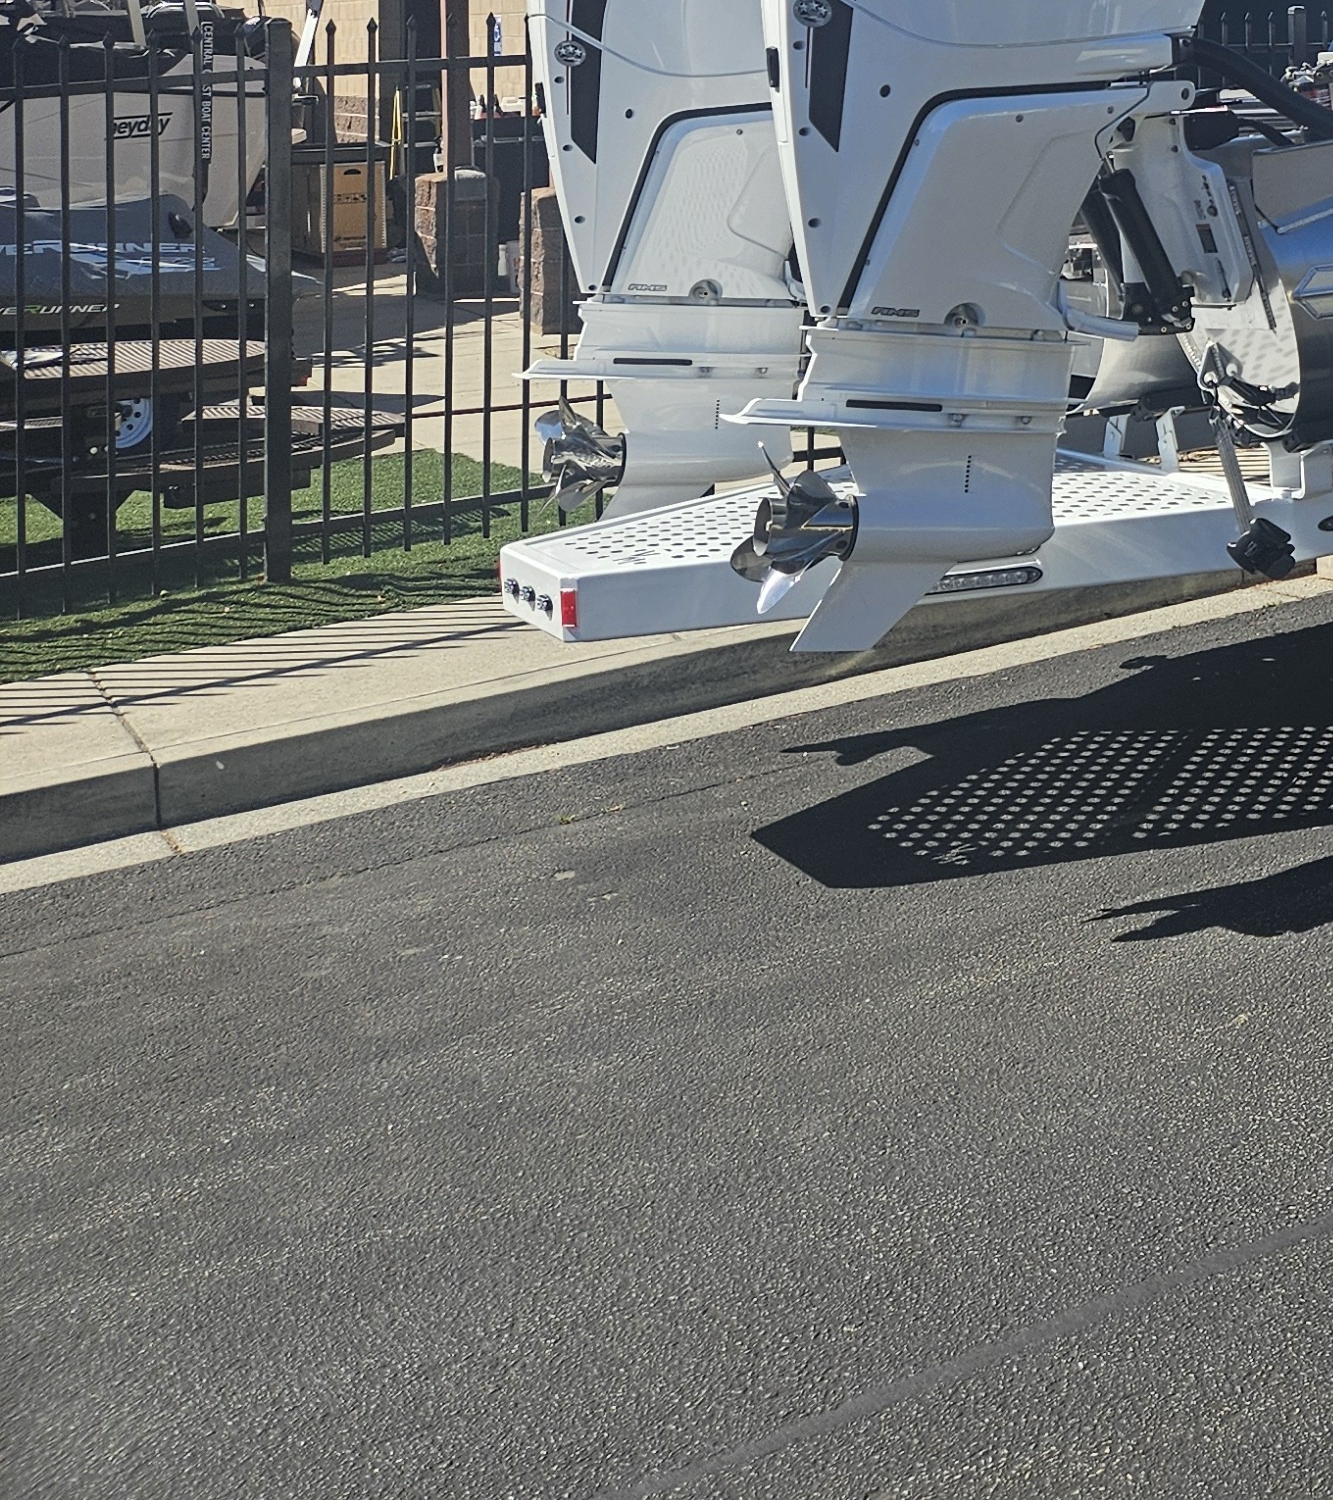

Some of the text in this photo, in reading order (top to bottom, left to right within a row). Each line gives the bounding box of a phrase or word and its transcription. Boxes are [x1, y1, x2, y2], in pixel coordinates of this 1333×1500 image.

[112, 114, 171, 137] eydy
[200, 25, 214, 159] CENTRAL CST BOAT CENTER
